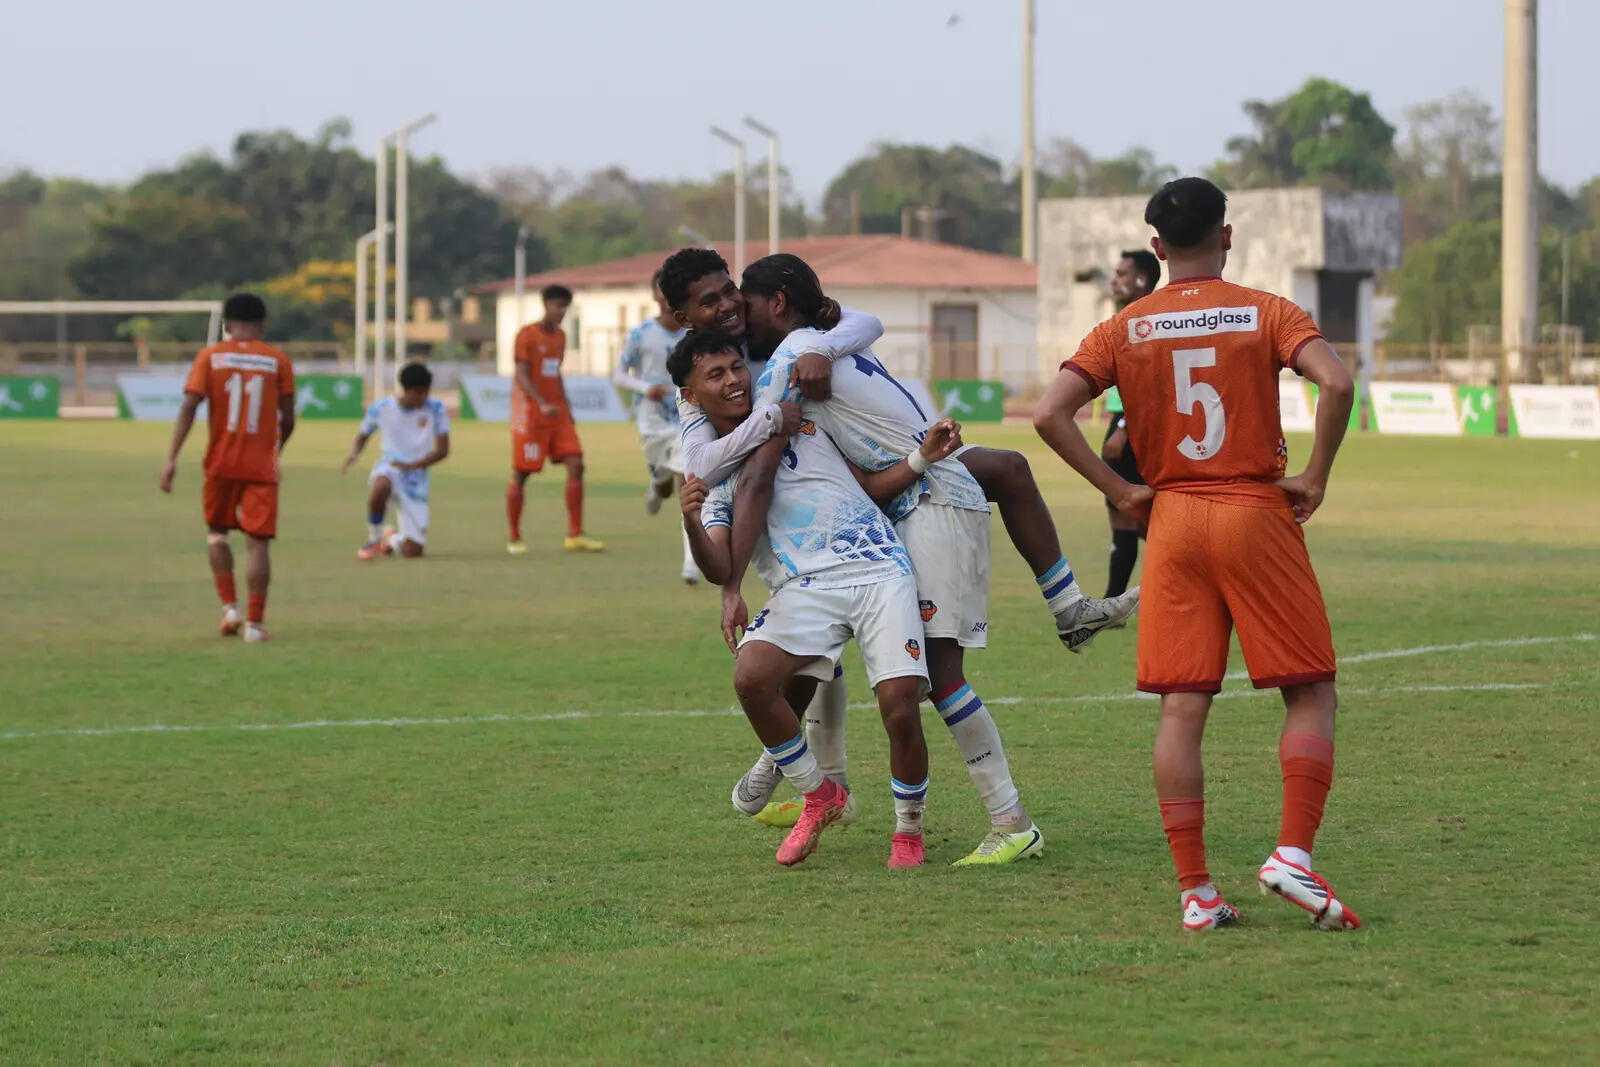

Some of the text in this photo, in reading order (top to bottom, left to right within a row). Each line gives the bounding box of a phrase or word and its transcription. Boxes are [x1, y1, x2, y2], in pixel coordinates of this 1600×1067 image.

[1155, 311, 1251, 330] roundglass
[224, 371, 265, 435] 11
[1172, 347, 1226, 461] 5
